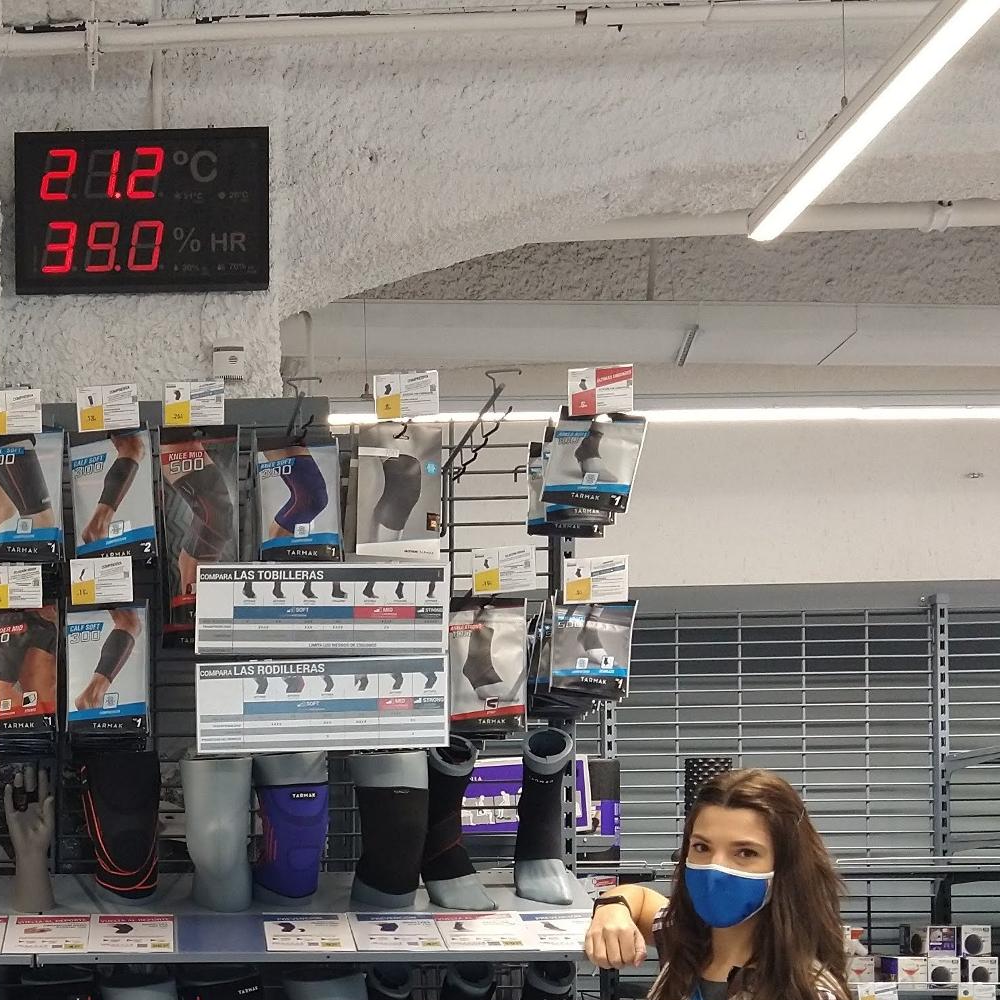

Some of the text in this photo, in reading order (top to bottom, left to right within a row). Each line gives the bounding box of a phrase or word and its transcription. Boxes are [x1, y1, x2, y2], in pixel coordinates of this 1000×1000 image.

[41, 220, 164, 273] 39.0
[210, 232, 247, 253] HR
[169, 451, 203, 462] KNEE MID
[169, 457, 204, 475] 500
[6, 546, 38, 554] TARMAK
[287, 549, 317, 557] TARMAK
[234, 571, 255, 580] LAS
[258, 571, 324, 580] TOBILLERAS
[69, 623, 101, 633] CALF SOFT
[70, 632, 101, 644] 300
[200, 663, 325, 677] COMPARA LAS RODILLERAS
